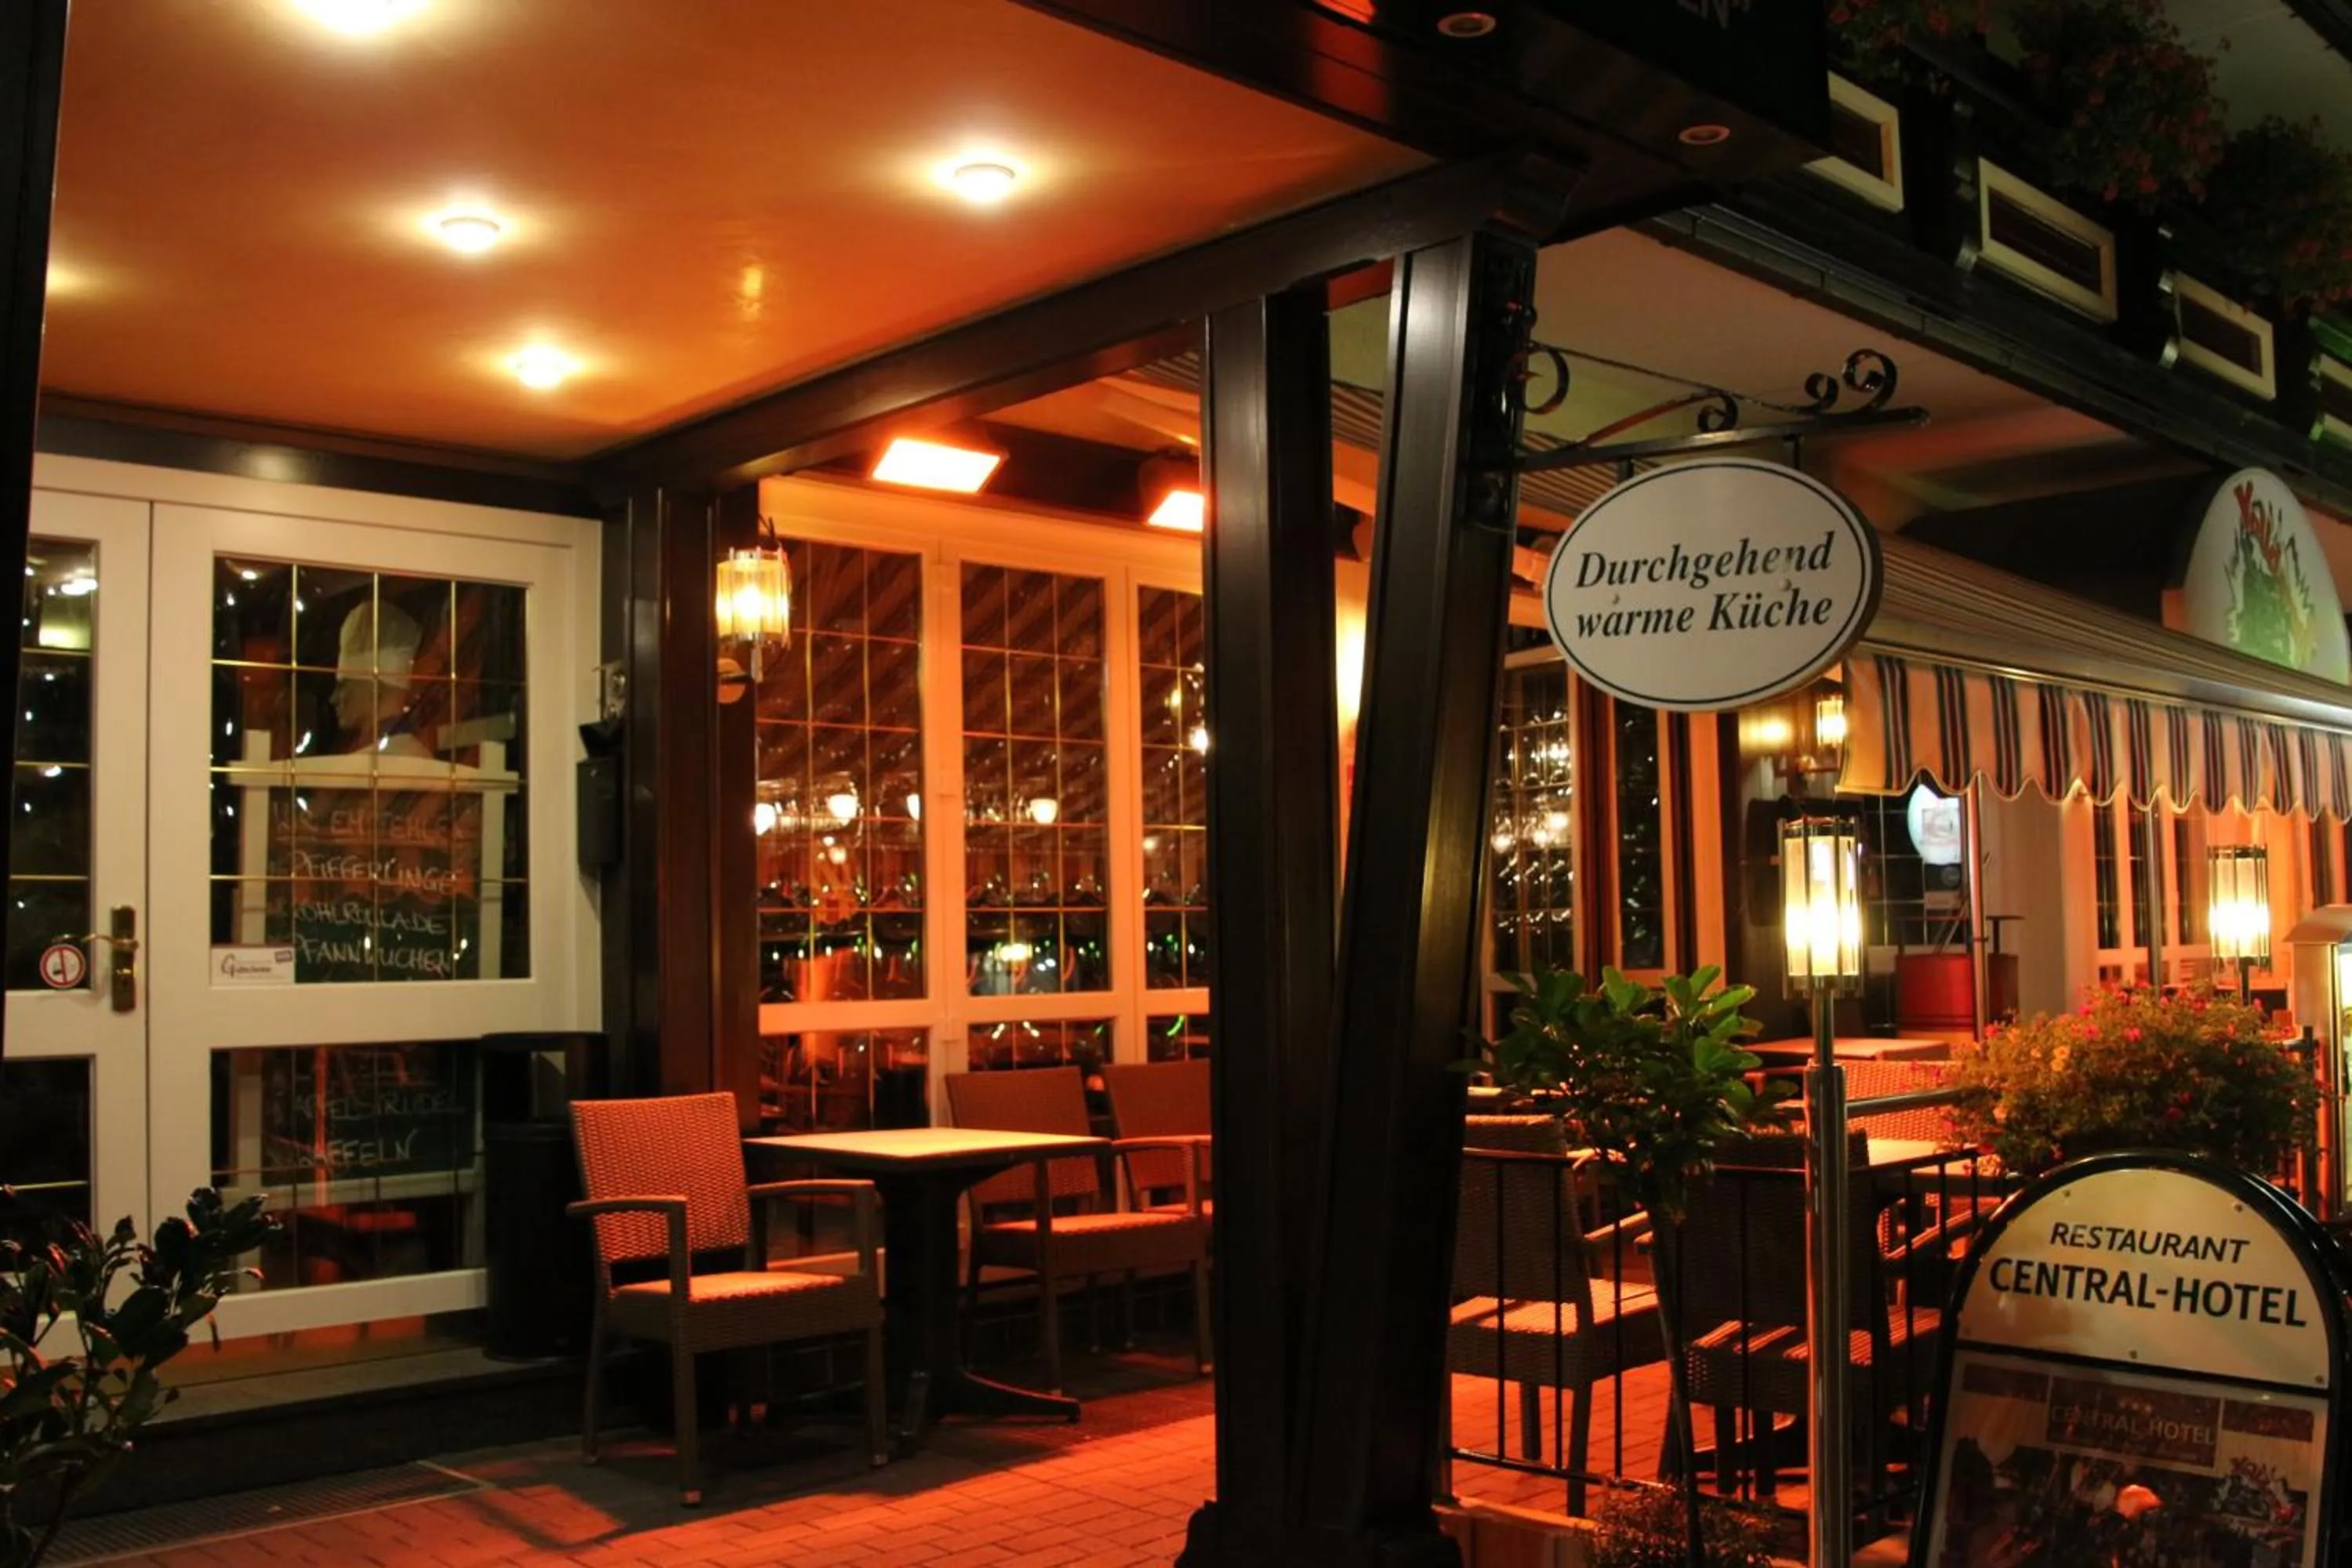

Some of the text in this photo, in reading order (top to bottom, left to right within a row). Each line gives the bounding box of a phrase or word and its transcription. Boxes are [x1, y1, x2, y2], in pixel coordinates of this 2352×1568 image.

[1574, 530, 1837, 589] Durchgehend
[1576, 586, 1833, 639] warme Küche
[2049, 1221, 2250, 1264] RESTAURANT
[1989, 1257, 2307, 1328] CENTRAL-HOTEL
